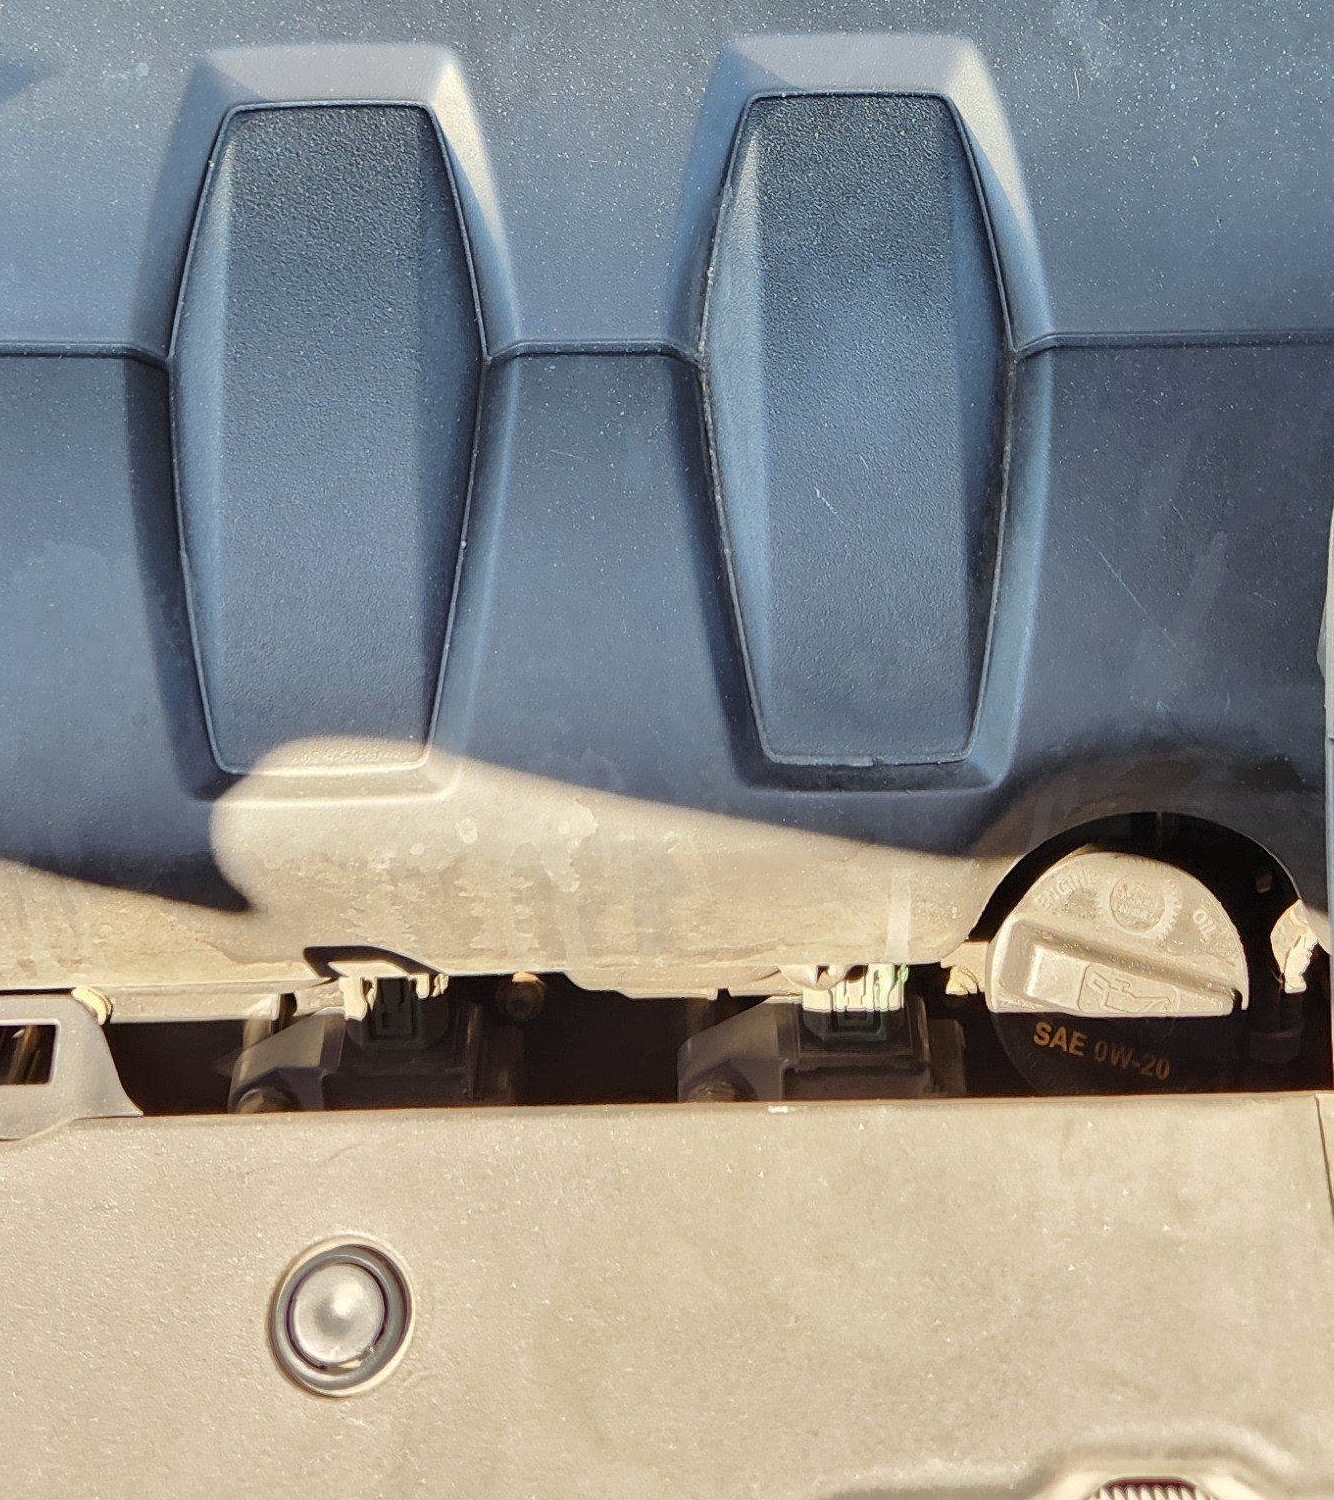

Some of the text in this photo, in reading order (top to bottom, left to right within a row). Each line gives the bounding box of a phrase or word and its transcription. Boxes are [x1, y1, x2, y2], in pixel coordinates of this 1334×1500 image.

[1034, 868, 1100, 910] ENGINE
[1192, 907, 1216, 944] OIL
[1033, 1021, 1171, 1080] SAE 0W-20
